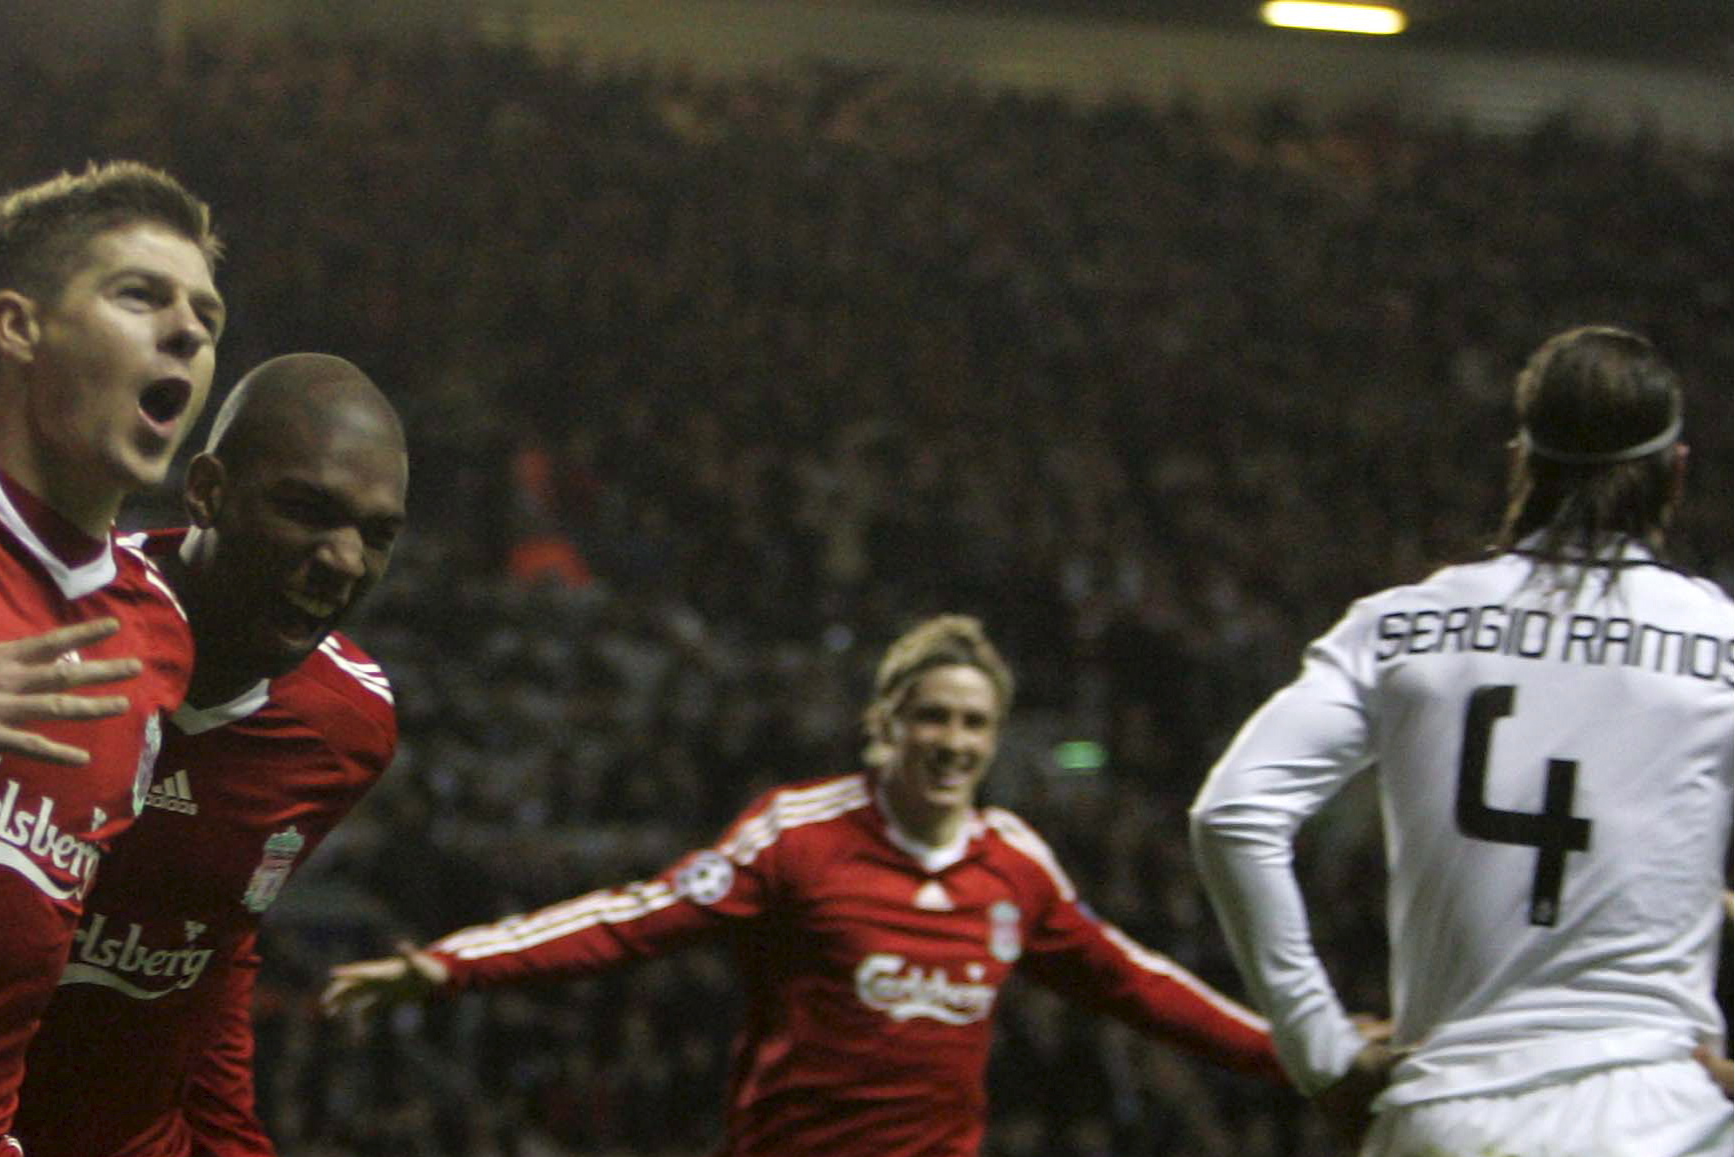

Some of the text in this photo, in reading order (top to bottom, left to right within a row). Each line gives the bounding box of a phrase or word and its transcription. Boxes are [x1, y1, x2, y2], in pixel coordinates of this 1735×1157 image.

[1375, 604, 1552, 662] SERGIO
[1456, 684, 1594, 927] 4
[76, 912, 217, 990] lsberg
